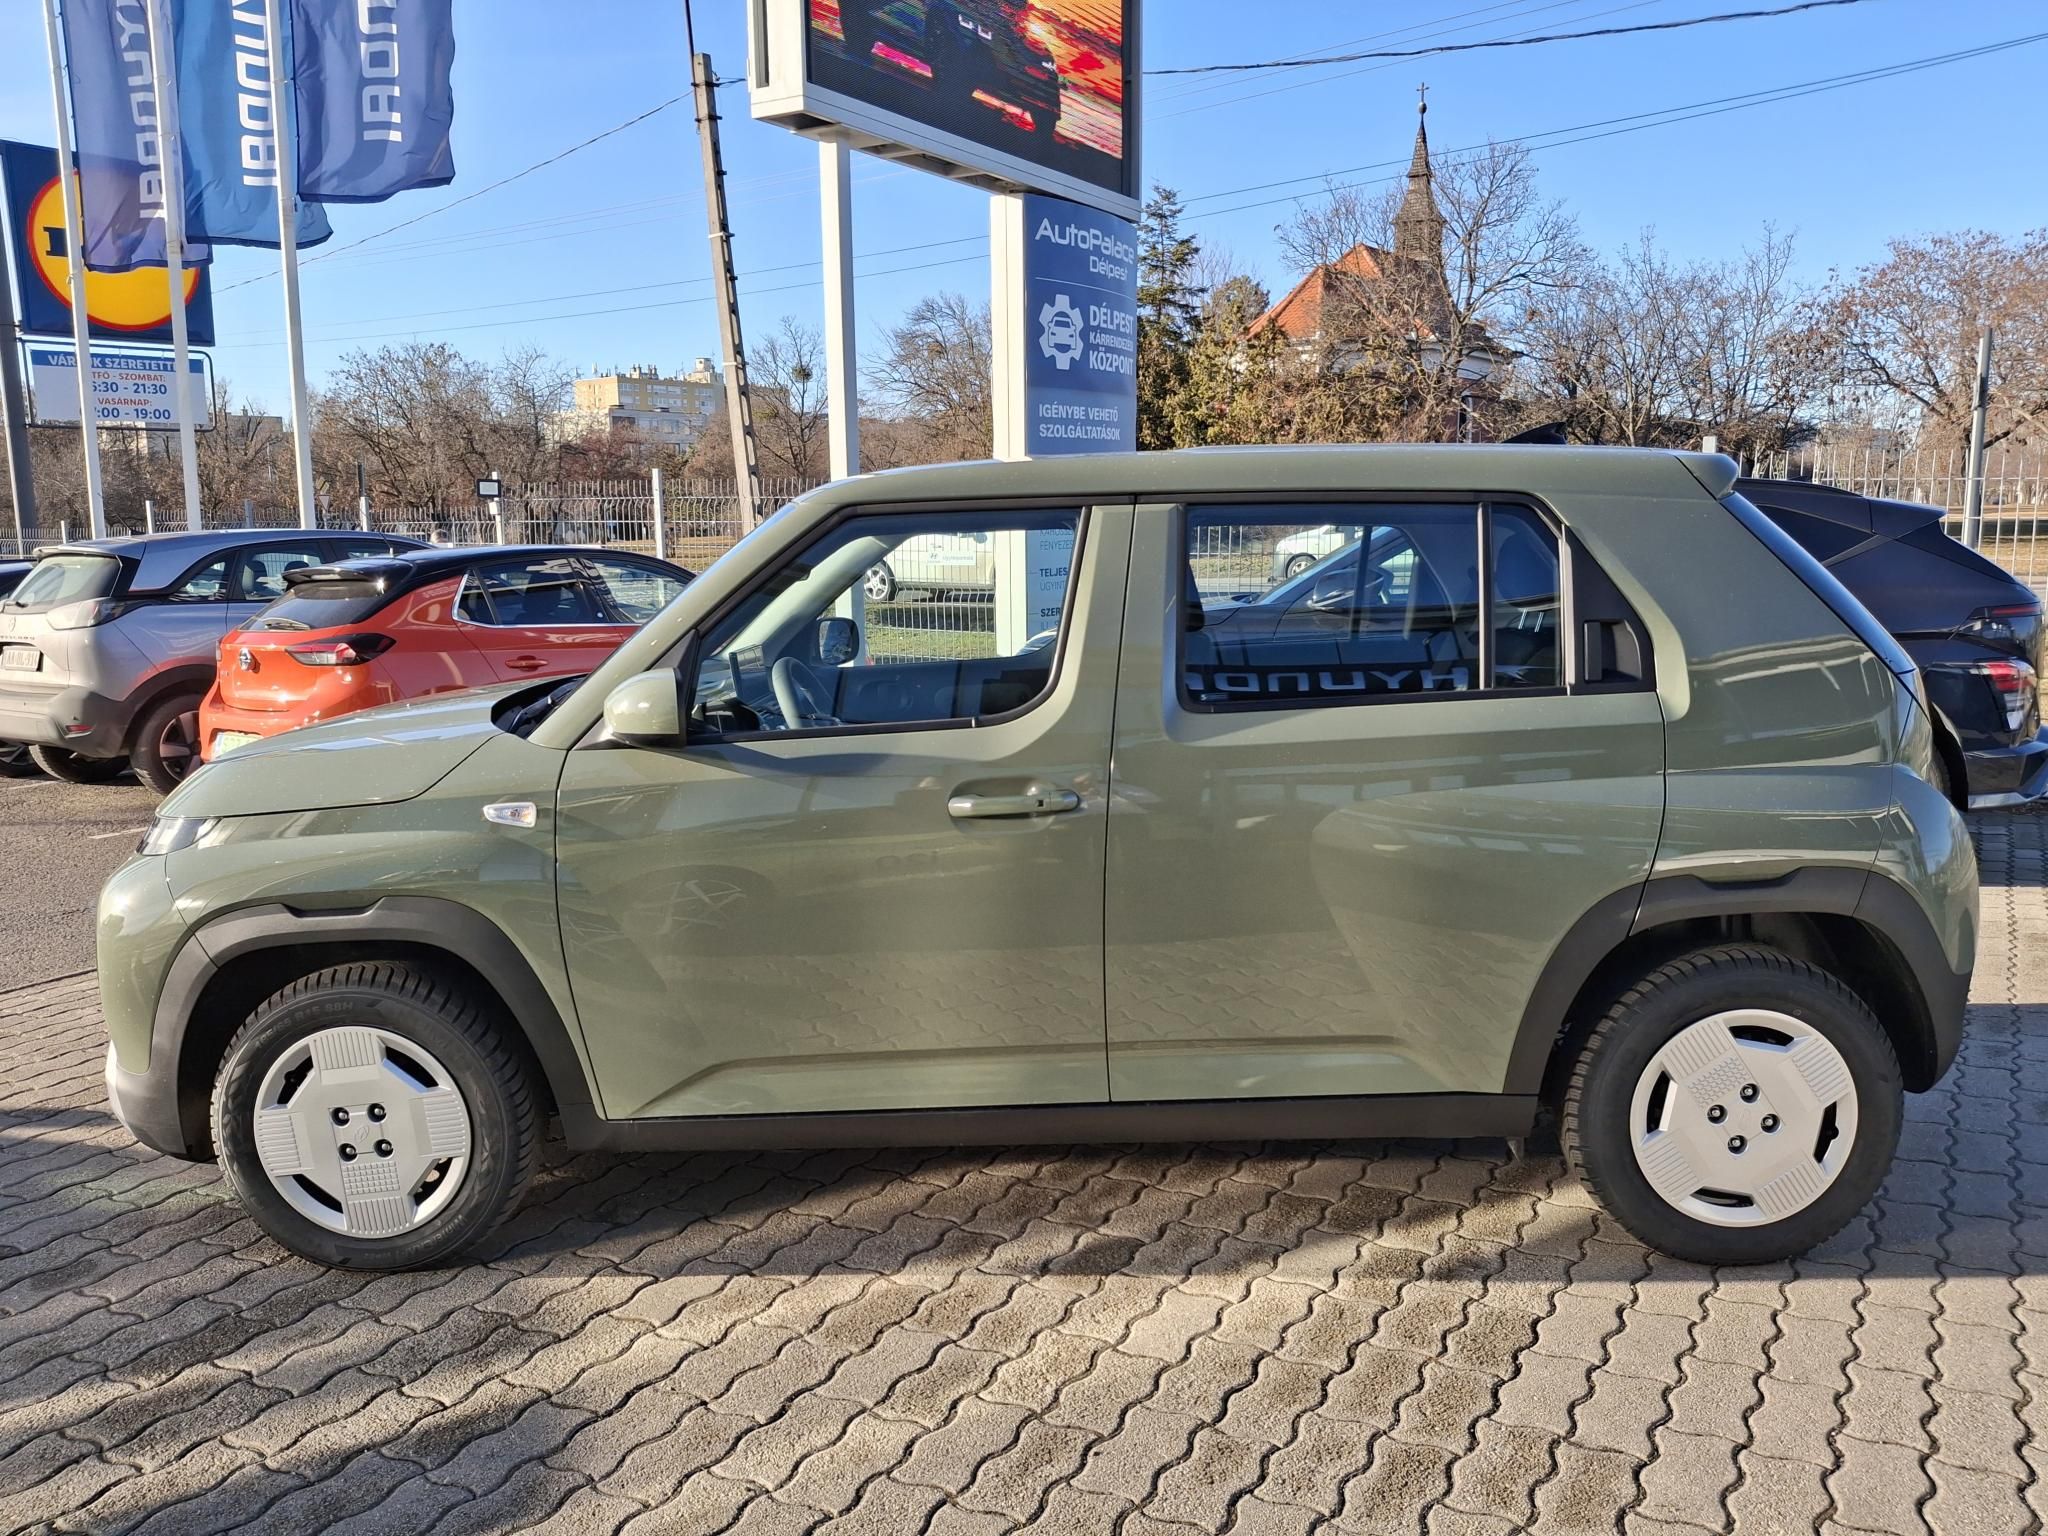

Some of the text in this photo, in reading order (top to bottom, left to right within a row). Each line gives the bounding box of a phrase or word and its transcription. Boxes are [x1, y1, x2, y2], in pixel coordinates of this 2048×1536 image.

[1034, 217, 1135, 264] AutoPalace
[1089, 255, 1128, 281] Délpest
[1089, 302, 1134, 335] DÉLPEST
[47, 354, 176, 371] VÁRK SZERETETT
[1089, 347, 1134, 376] KÖZPONT
[119, 372, 166, 383] SZOMBAT:
[133, 383, 168, 395] 21:30
[97, 397, 153, 407] VASÁRNAP:
[133, 408, 171, 420] 19:00
[1039, 401, 1119, 422] IGÉNYBE VEHETŐ
[1039, 422, 1121, 441] SZOLGÁLTATÁSOK
[1040, 567, 1068, 578] TELJES
